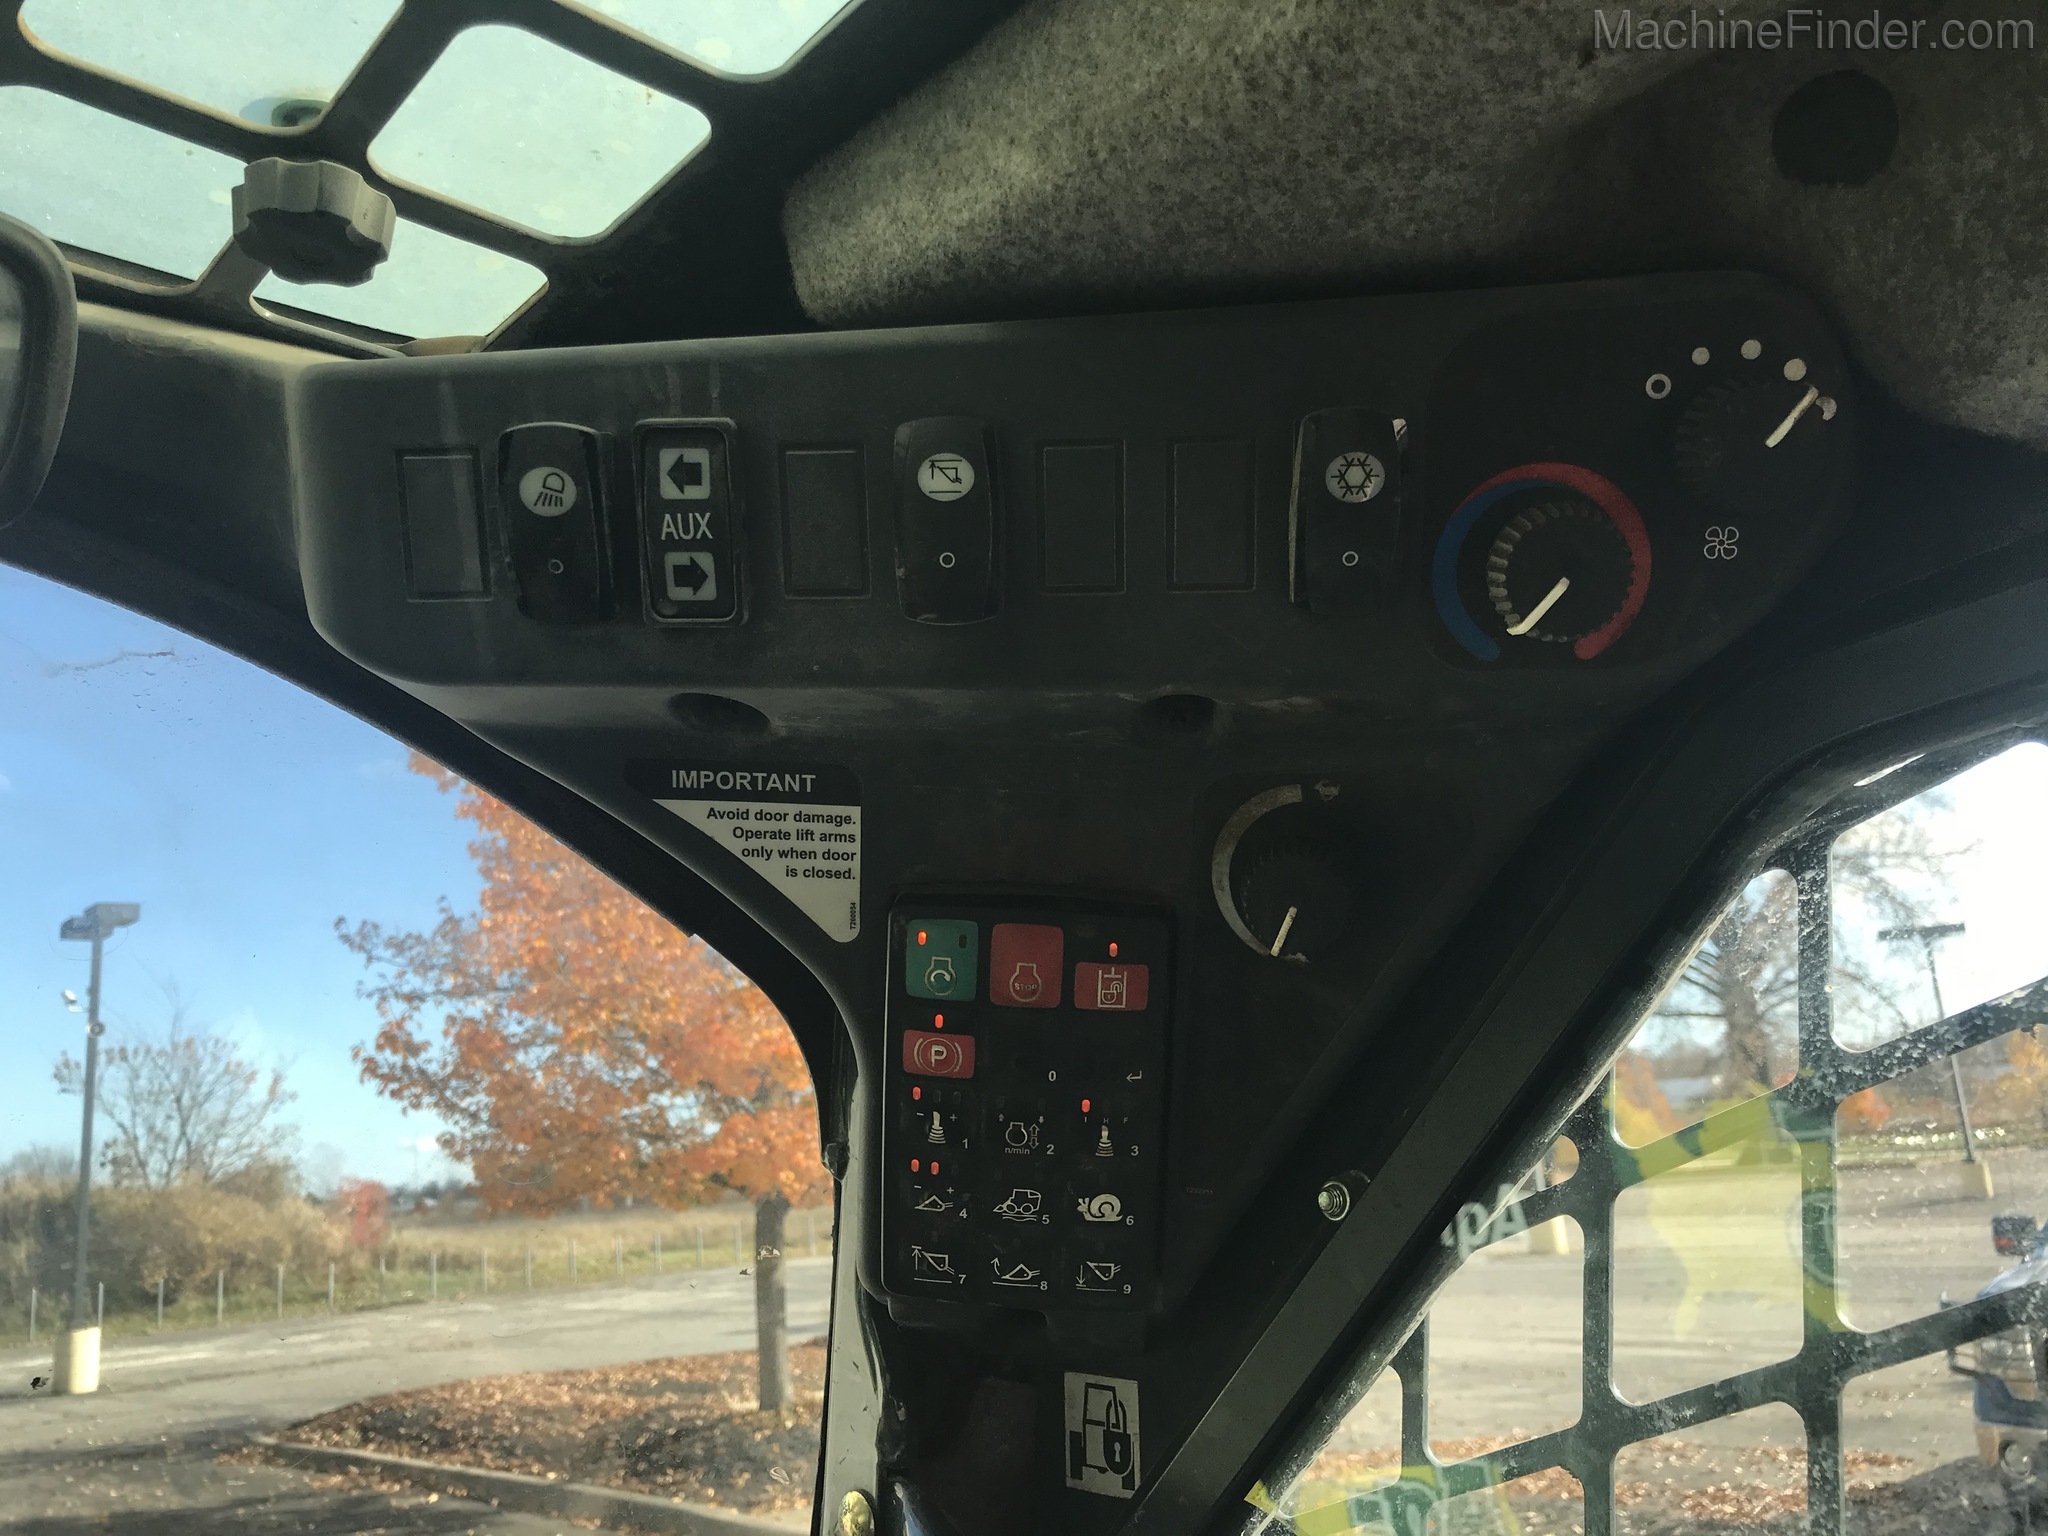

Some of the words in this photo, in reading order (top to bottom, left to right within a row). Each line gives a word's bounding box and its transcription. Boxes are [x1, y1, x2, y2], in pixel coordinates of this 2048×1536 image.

[661, 512, 713, 541] AUX
[671, 770, 816, 793] IMPORTANT
[707, 807, 750, 821] Avoid
[754, 808, 789, 822] door
[793, 810, 857, 827] damage.
[733, 826, 791, 842] Operate
[796, 829, 815, 842] lift
[819, 833, 856, 843] arms
[741, 846, 774, 861] only
[778, 847, 817, 860] when
[822, 849, 857, 862] door
[785, 865, 798, 878] is
[802, 866, 856, 880] closed.
[1014, 982, 1038, 991] STOP
[1046, 1144, 1055, 1155] 2
[1130, 1145, 1140, 1157] 3
[958, 1208, 969, 1219] 4
[1041, 1215, 1051, 1226] 5
[1125, 1216, 1135, 1227] 6
[958, 1275, 967, 1285] 7
[1038, 1281, 1049, 1292] 8
[1122, 1284, 1133, 1295] 9
